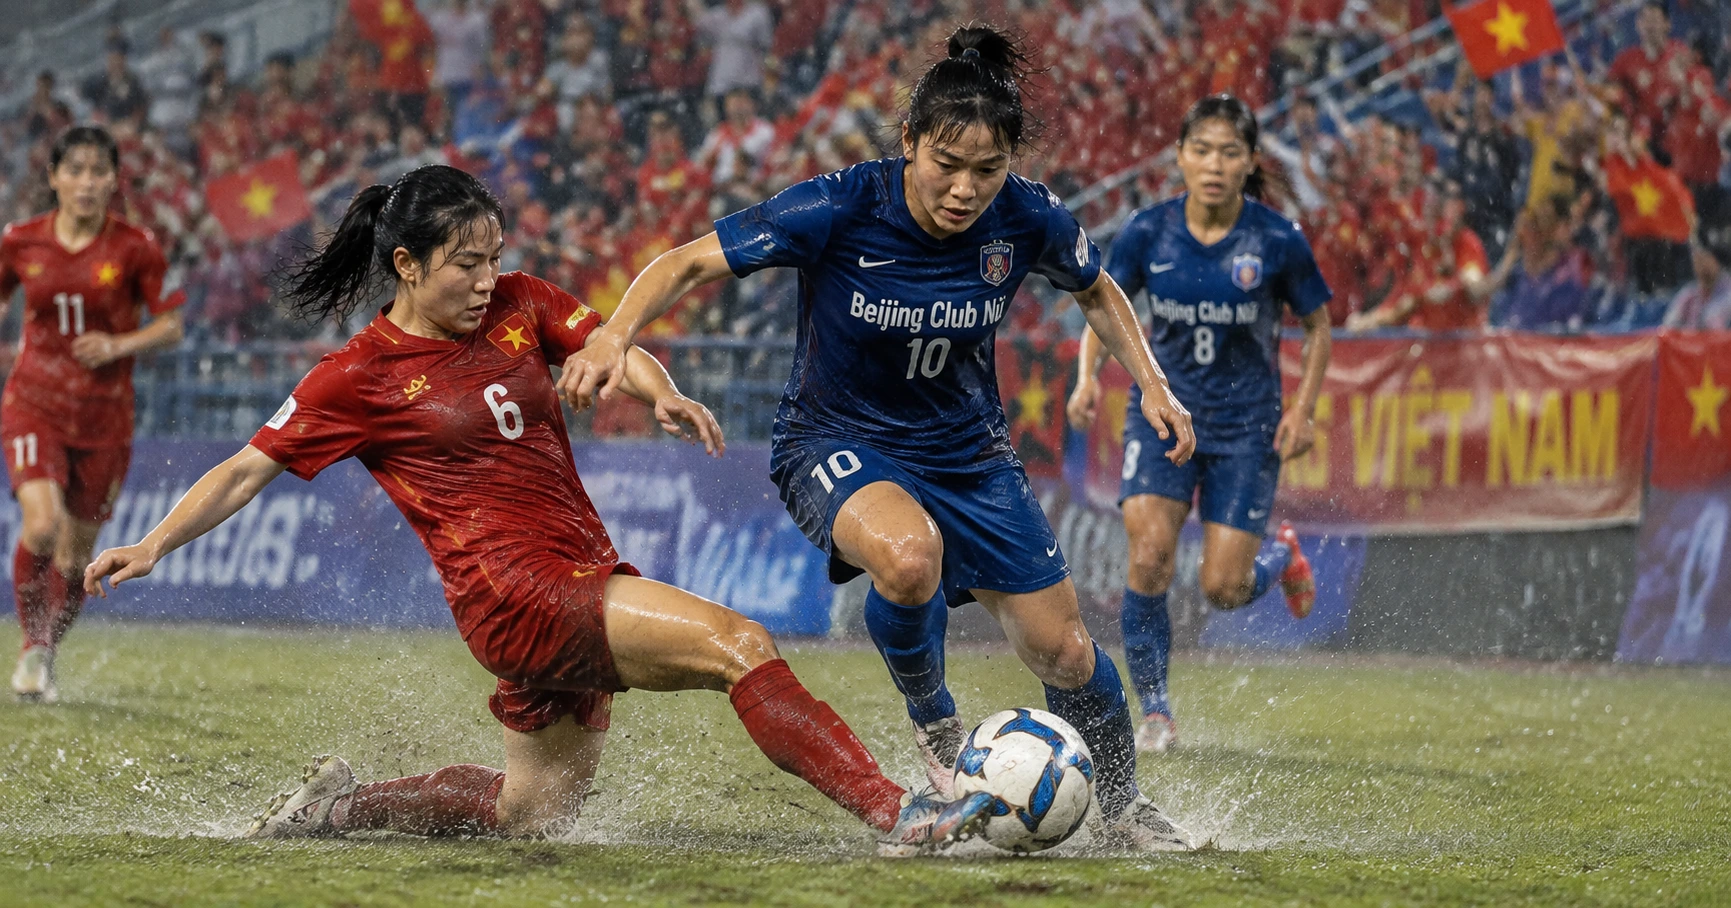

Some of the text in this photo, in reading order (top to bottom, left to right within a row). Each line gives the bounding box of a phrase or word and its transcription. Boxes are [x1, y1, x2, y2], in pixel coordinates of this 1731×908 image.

[53, 292, 85, 336] 11
[850, 291, 925, 333] Beijing
[930, 301, 977, 329] Club
[1198, 300, 1234, 325] Club
[906, 337, 951, 380] 10
[1194, 325, 1215, 365] 8
[484, 383, 525, 440] 6
[13, 432, 38, 468] 11
[1486, 388, 1619, 486] NAM
[810, 450, 862, 494] 10
